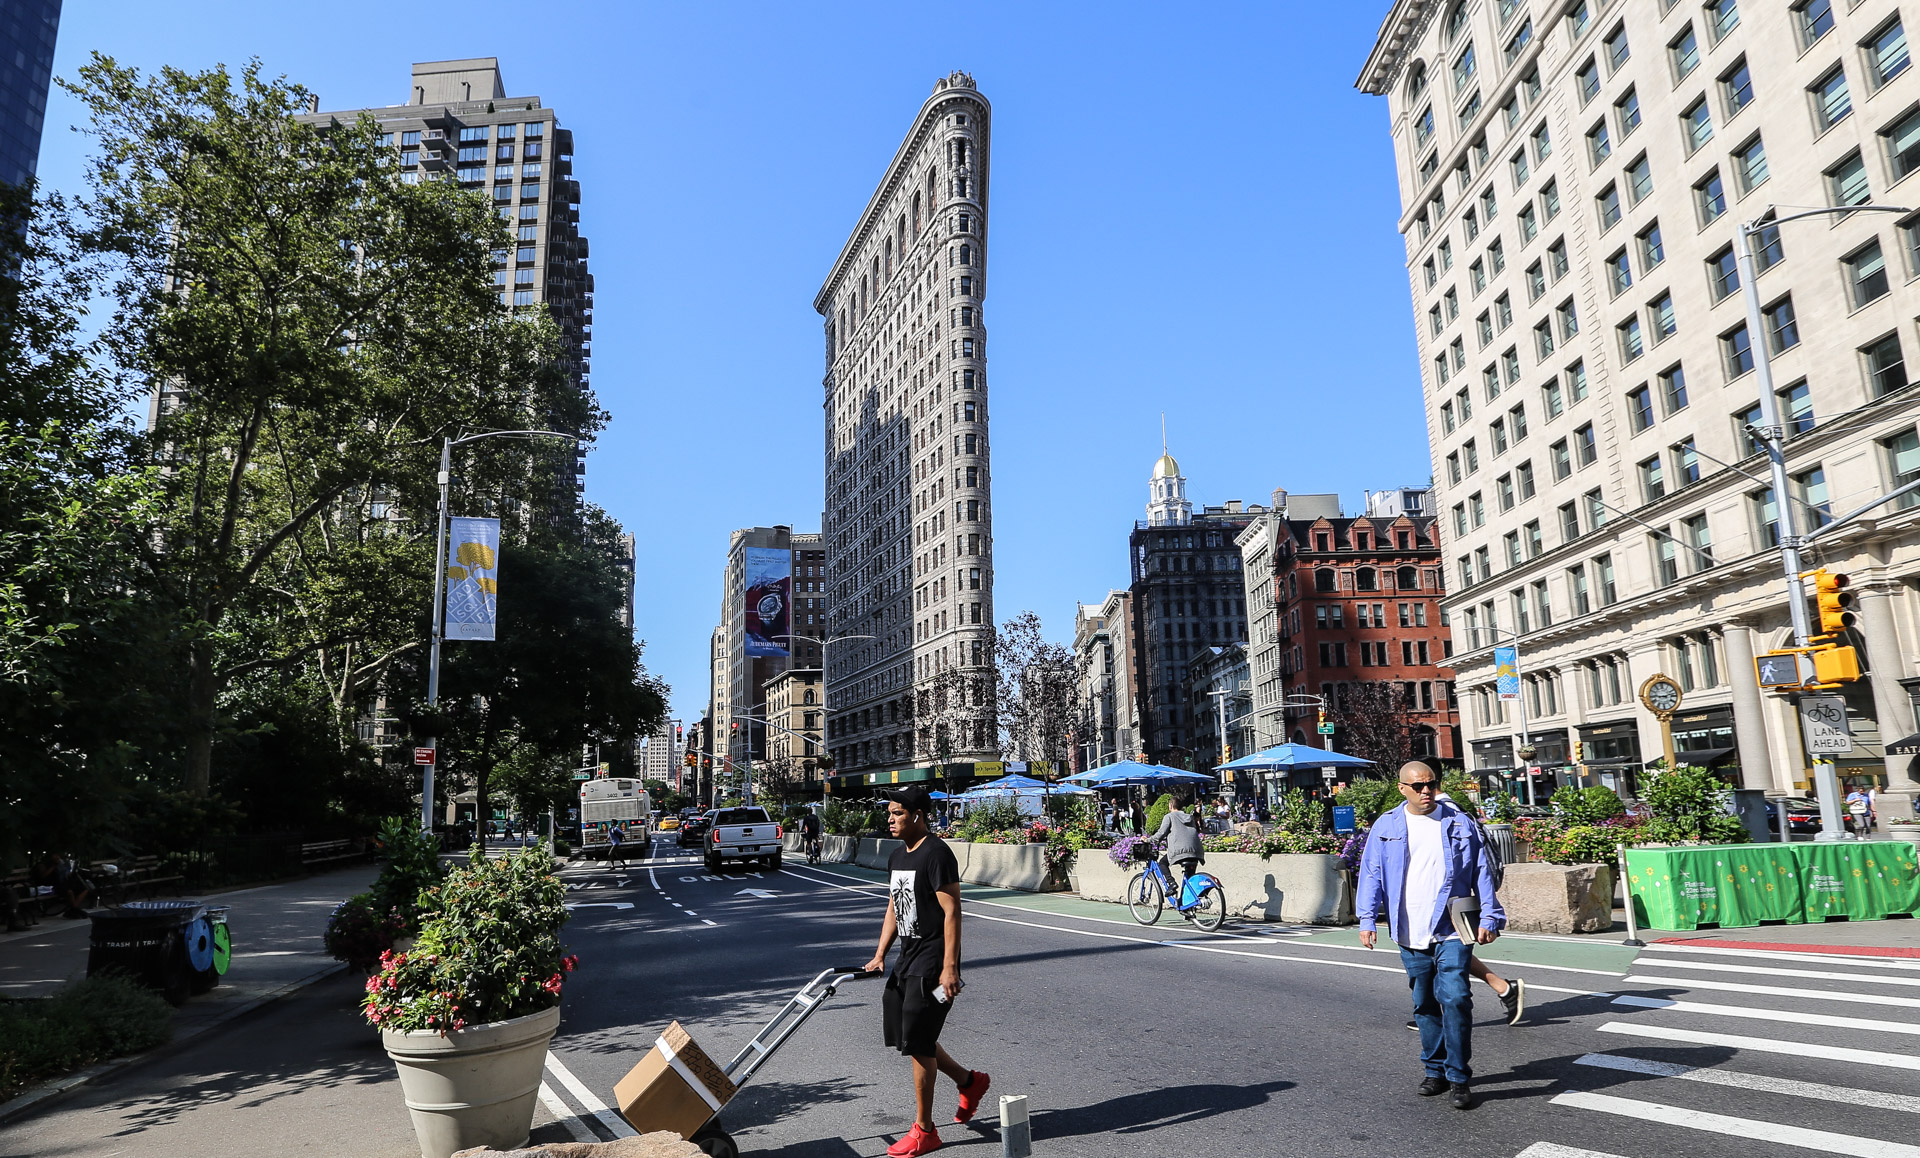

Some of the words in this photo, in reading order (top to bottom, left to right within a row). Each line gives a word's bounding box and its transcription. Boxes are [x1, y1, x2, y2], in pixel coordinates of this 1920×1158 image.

[456, 602, 478, 618] SQ.
[1813, 727, 1842, 736] LANE
[1813, 738, 1847, 748] AHEAD
[678, 871, 765, 883] ONLY
[566, 879, 632, 890] NLY
